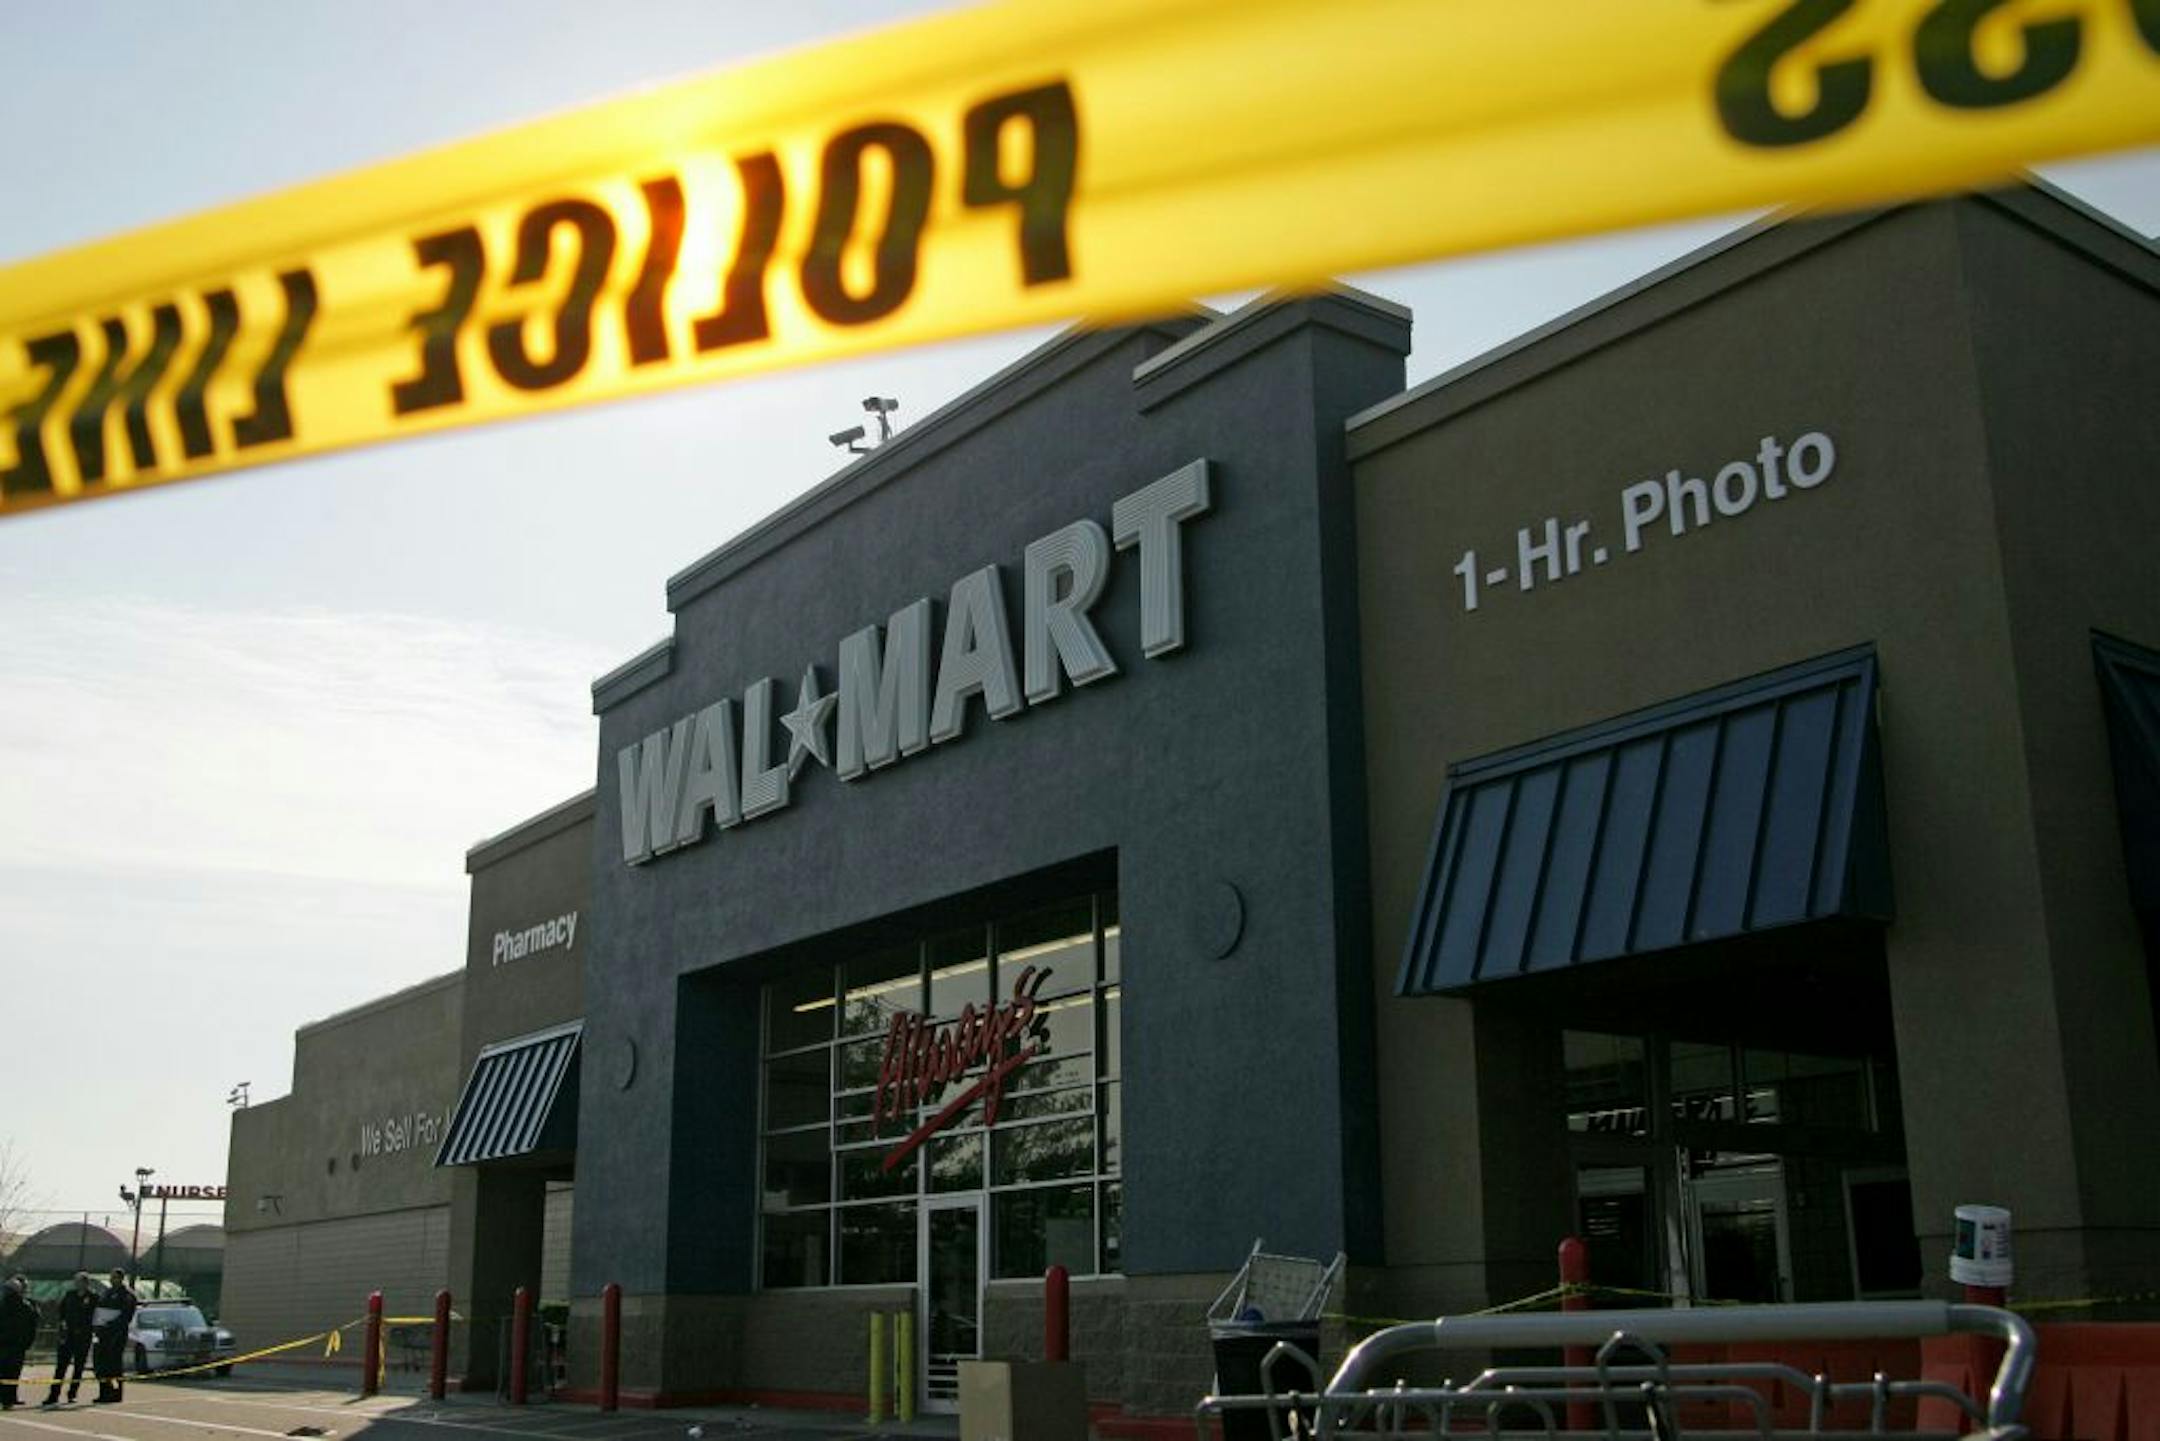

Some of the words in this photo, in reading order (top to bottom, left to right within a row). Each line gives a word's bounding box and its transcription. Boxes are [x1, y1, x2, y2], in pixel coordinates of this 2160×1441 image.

[1622, 431, 1836, 553] Photo
[492, 911, 578, 967] Pharmacy
[361, 1123, 382, 1157] We
[385, 1115, 413, 1153] Sell
[415, 1112, 443, 1147] For
